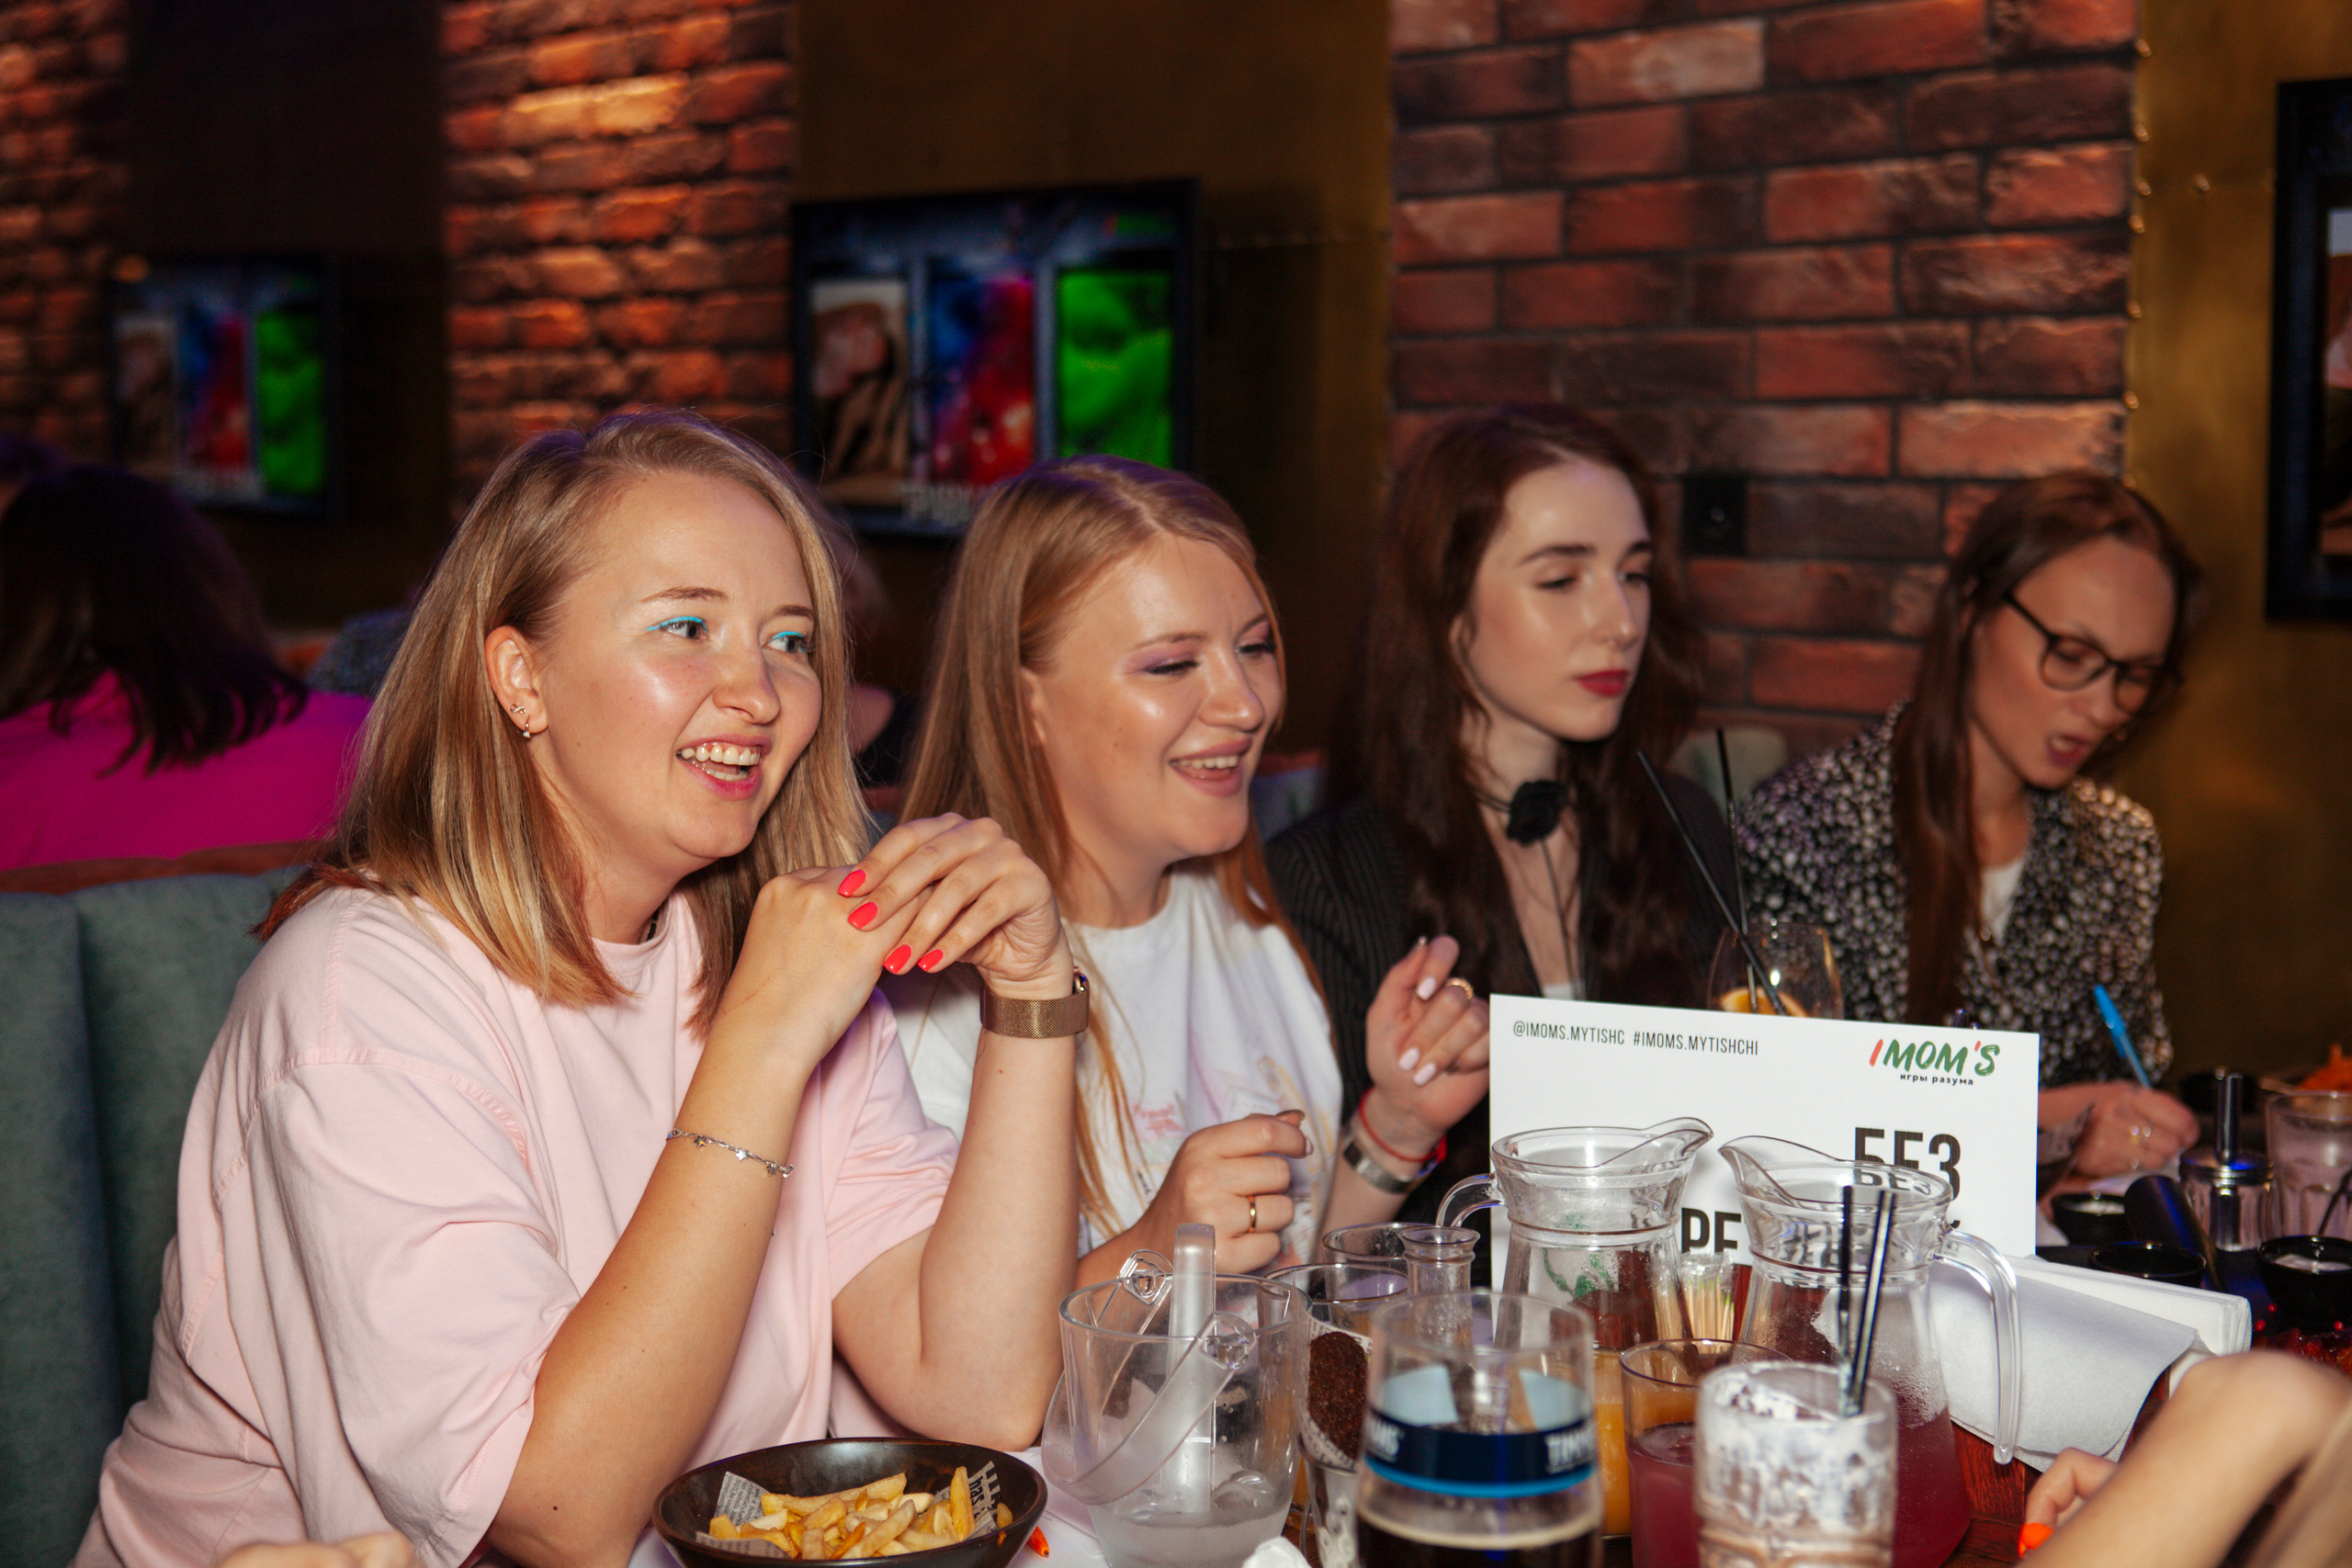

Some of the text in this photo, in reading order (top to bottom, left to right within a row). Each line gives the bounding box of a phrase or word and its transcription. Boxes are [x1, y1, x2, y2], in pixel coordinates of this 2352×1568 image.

[1513, 1021, 1758, 1055] @IMOMS.MYTISHC #IMOMS.MYTISHCHI
[1900, 1073, 1974, 1086] игры разума
